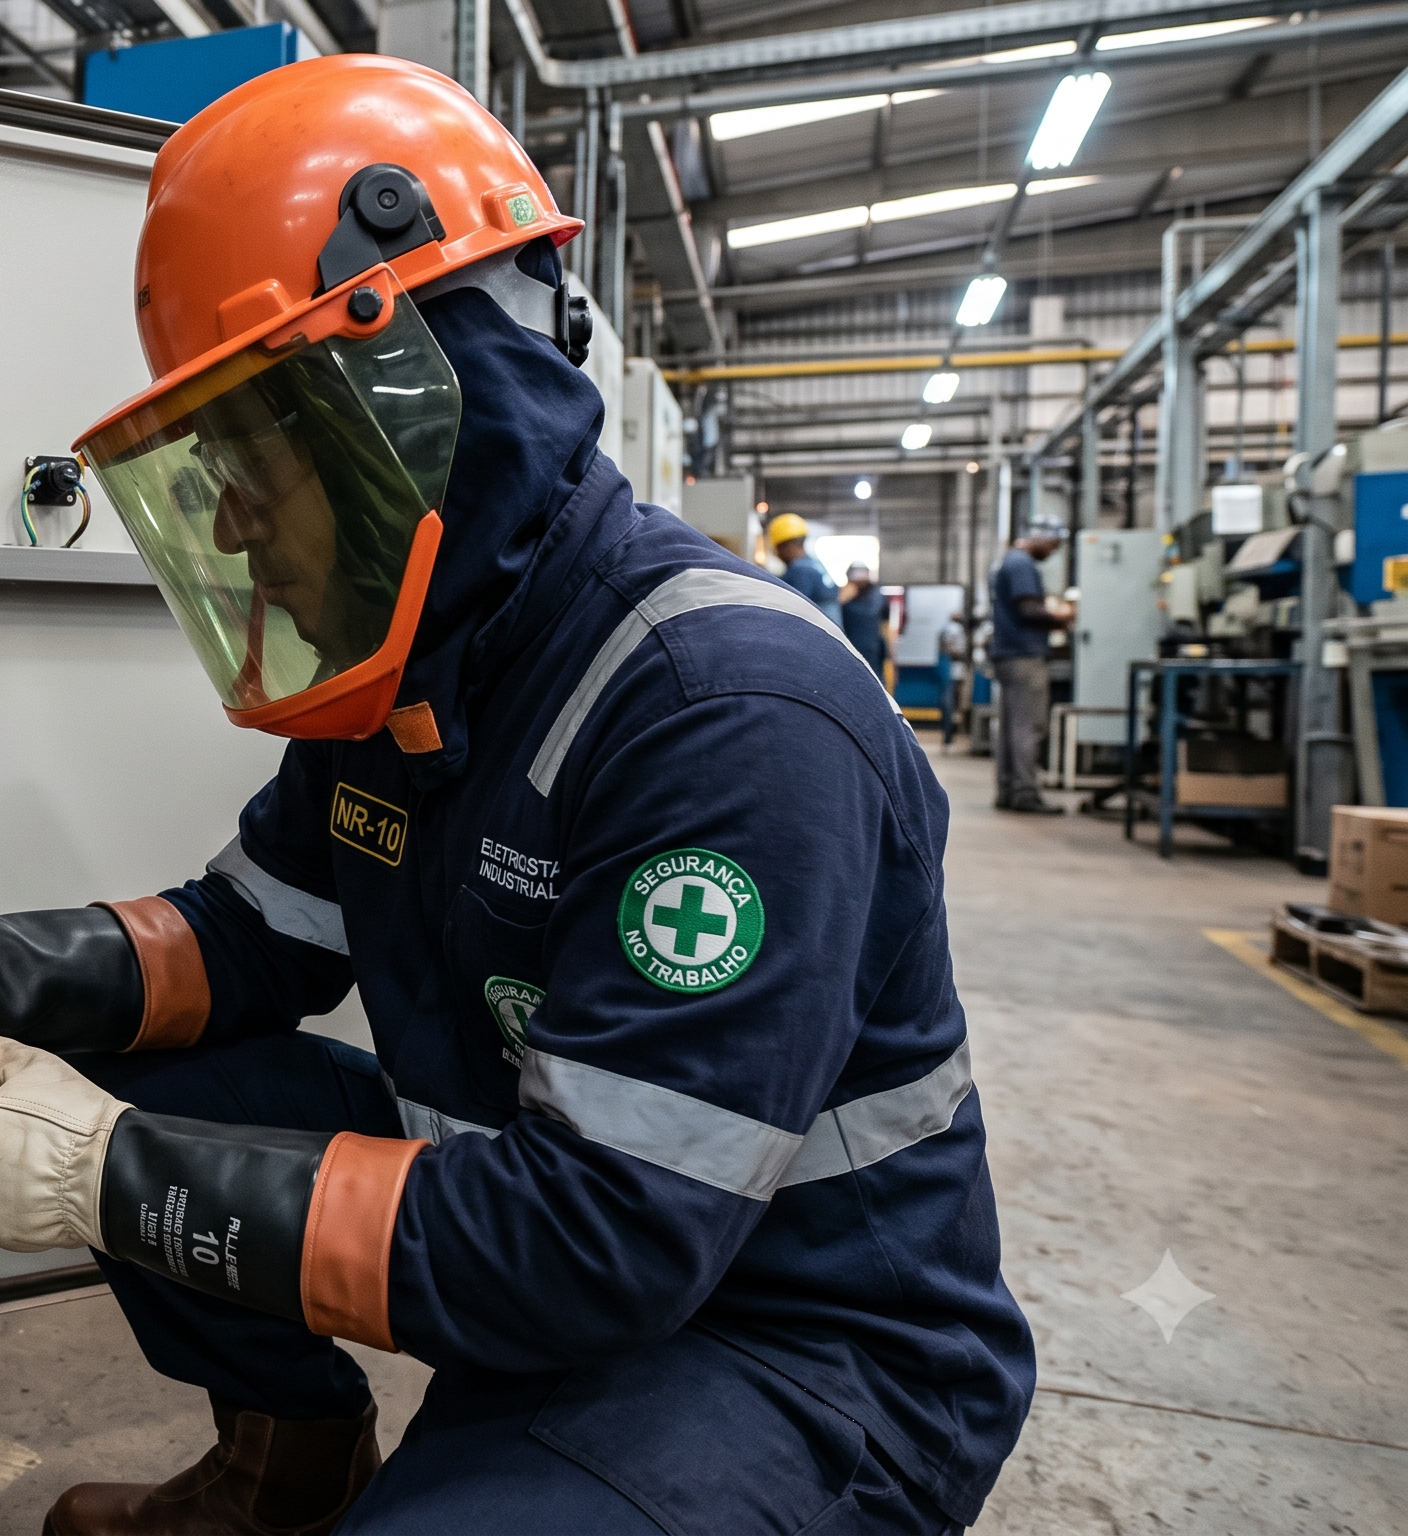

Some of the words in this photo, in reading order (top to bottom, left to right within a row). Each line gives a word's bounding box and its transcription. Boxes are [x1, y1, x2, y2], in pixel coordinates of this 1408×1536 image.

[336, 797, 400, 851] NR-10
[479, 859, 560, 900] INDUSTRIAL
[634, 856, 752, 908] SEGURANÇA
[625, 929, 648, 958] NO
[647, 945, 748, 986] TRABALHO
[192, 1231, 219, 1265] 10
